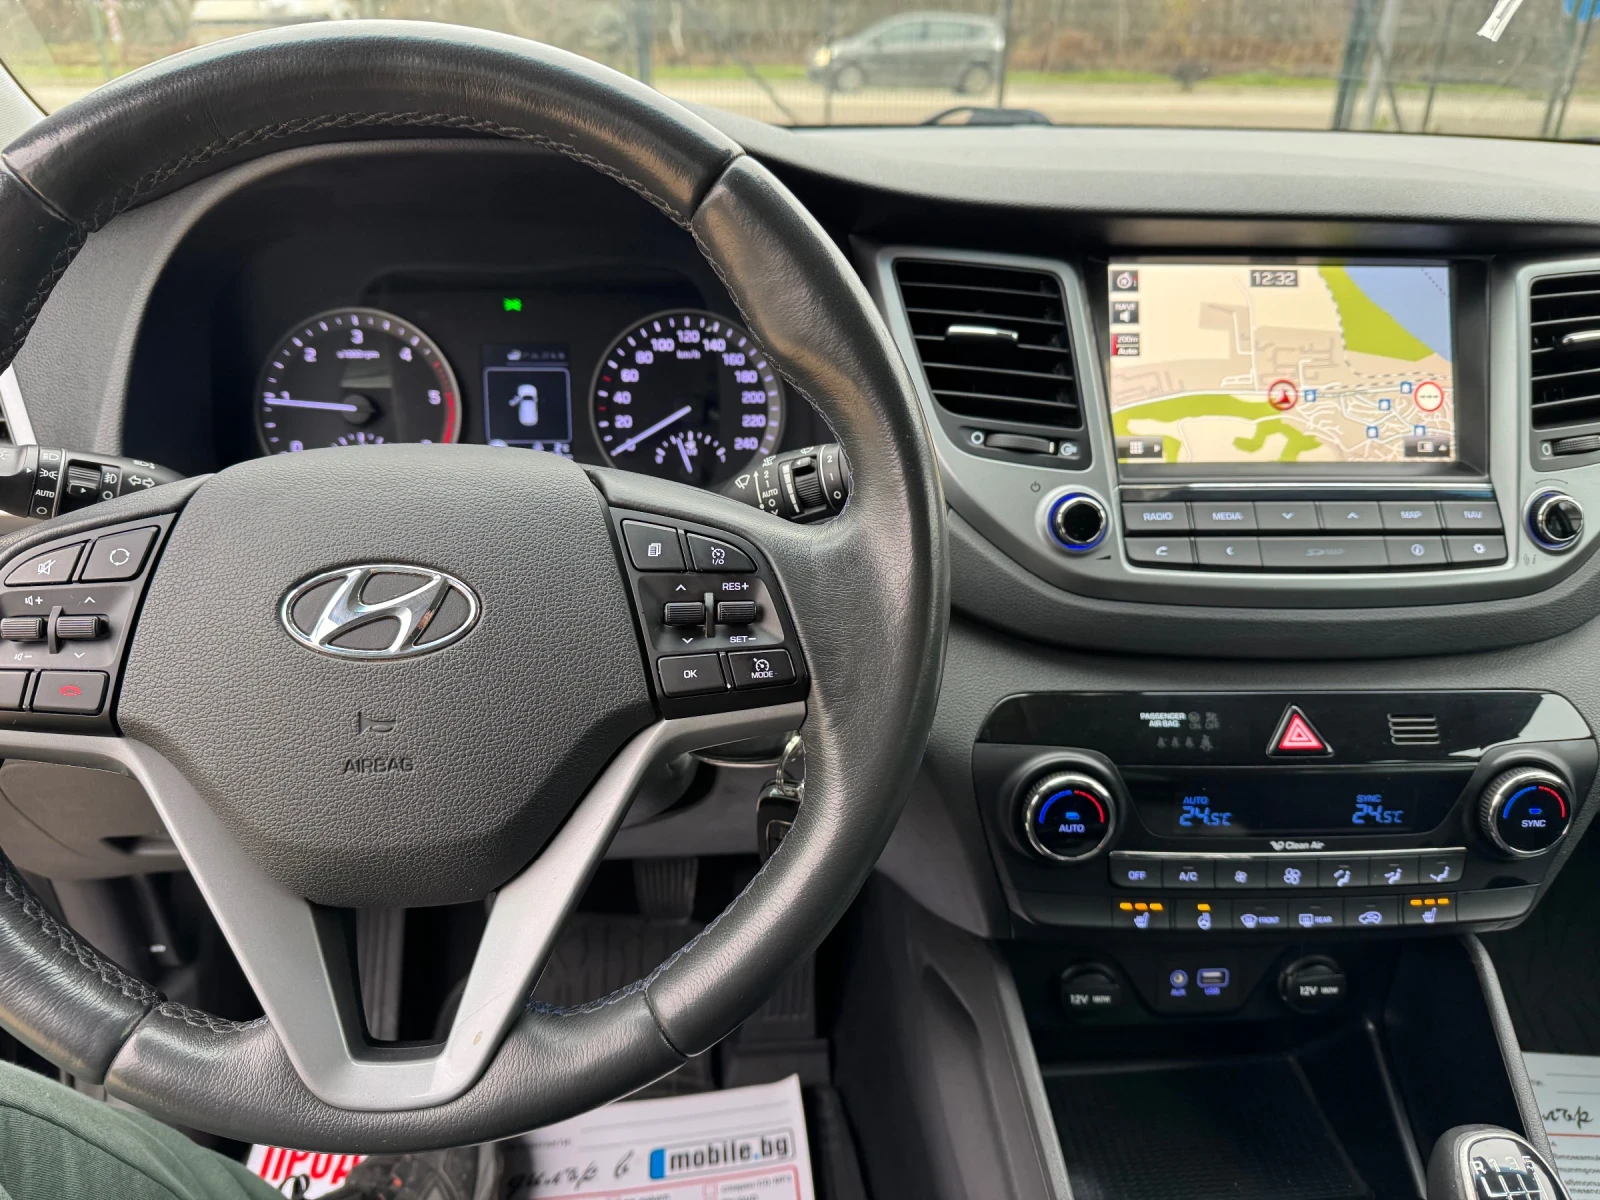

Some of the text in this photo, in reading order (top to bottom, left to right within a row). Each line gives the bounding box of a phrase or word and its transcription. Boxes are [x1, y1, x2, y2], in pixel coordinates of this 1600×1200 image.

[1252, 271, 1296, 286] 12:32
[351, 329, 363, 344] 3
[676, 329, 700, 343] 120
[651, 338, 675, 352] 100
[702, 338, 726, 352] 140
[303, 347, 317, 362] 2
[399, 347, 413, 362] 4
[635, 351, 653, 364] 80
[676, 350, 700, 360] km/h
[722, 353, 746, 366] 160
[620, 368, 639, 383] 60
[734, 370, 758, 384] 180
[612, 391, 631, 405] 40
[741, 391, 766, 404] 200
[614, 414, 633, 429] 20
[741, 414, 766, 428] 220
[733, 436, 759, 450] 240
[826, 454, 833, 464] 2
[763, 470, 770, 479] 2
[35, 489, 55, 499] AUTO
[762, 488, 778, 499] AUTO
[1143, 512, 1174, 521] RADIO
[1212, 512, 1242, 521] MEDIA
[1400, 510, 1422, 519] MAP
[684, 669, 698, 679] OK
[751, 671, 774, 679] MODE
[1140, 712, 1187, 721] PASSENGER
[343, 758, 414, 774] AIRBAG
[1183, 796, 1209, 805] AUTO
[1058, 823, 1085, 833] AUTO
[1521, 819, 1547, 828] SYNC
[1128, 871, 1147, 880] OFF
[1178, 871, 1199, 882] A/C
[1300, 986, 1318, 996] 12V
[670, 1136, 788, 1170] mobile.bg
[1470, 1160, 1487, 1175] R
